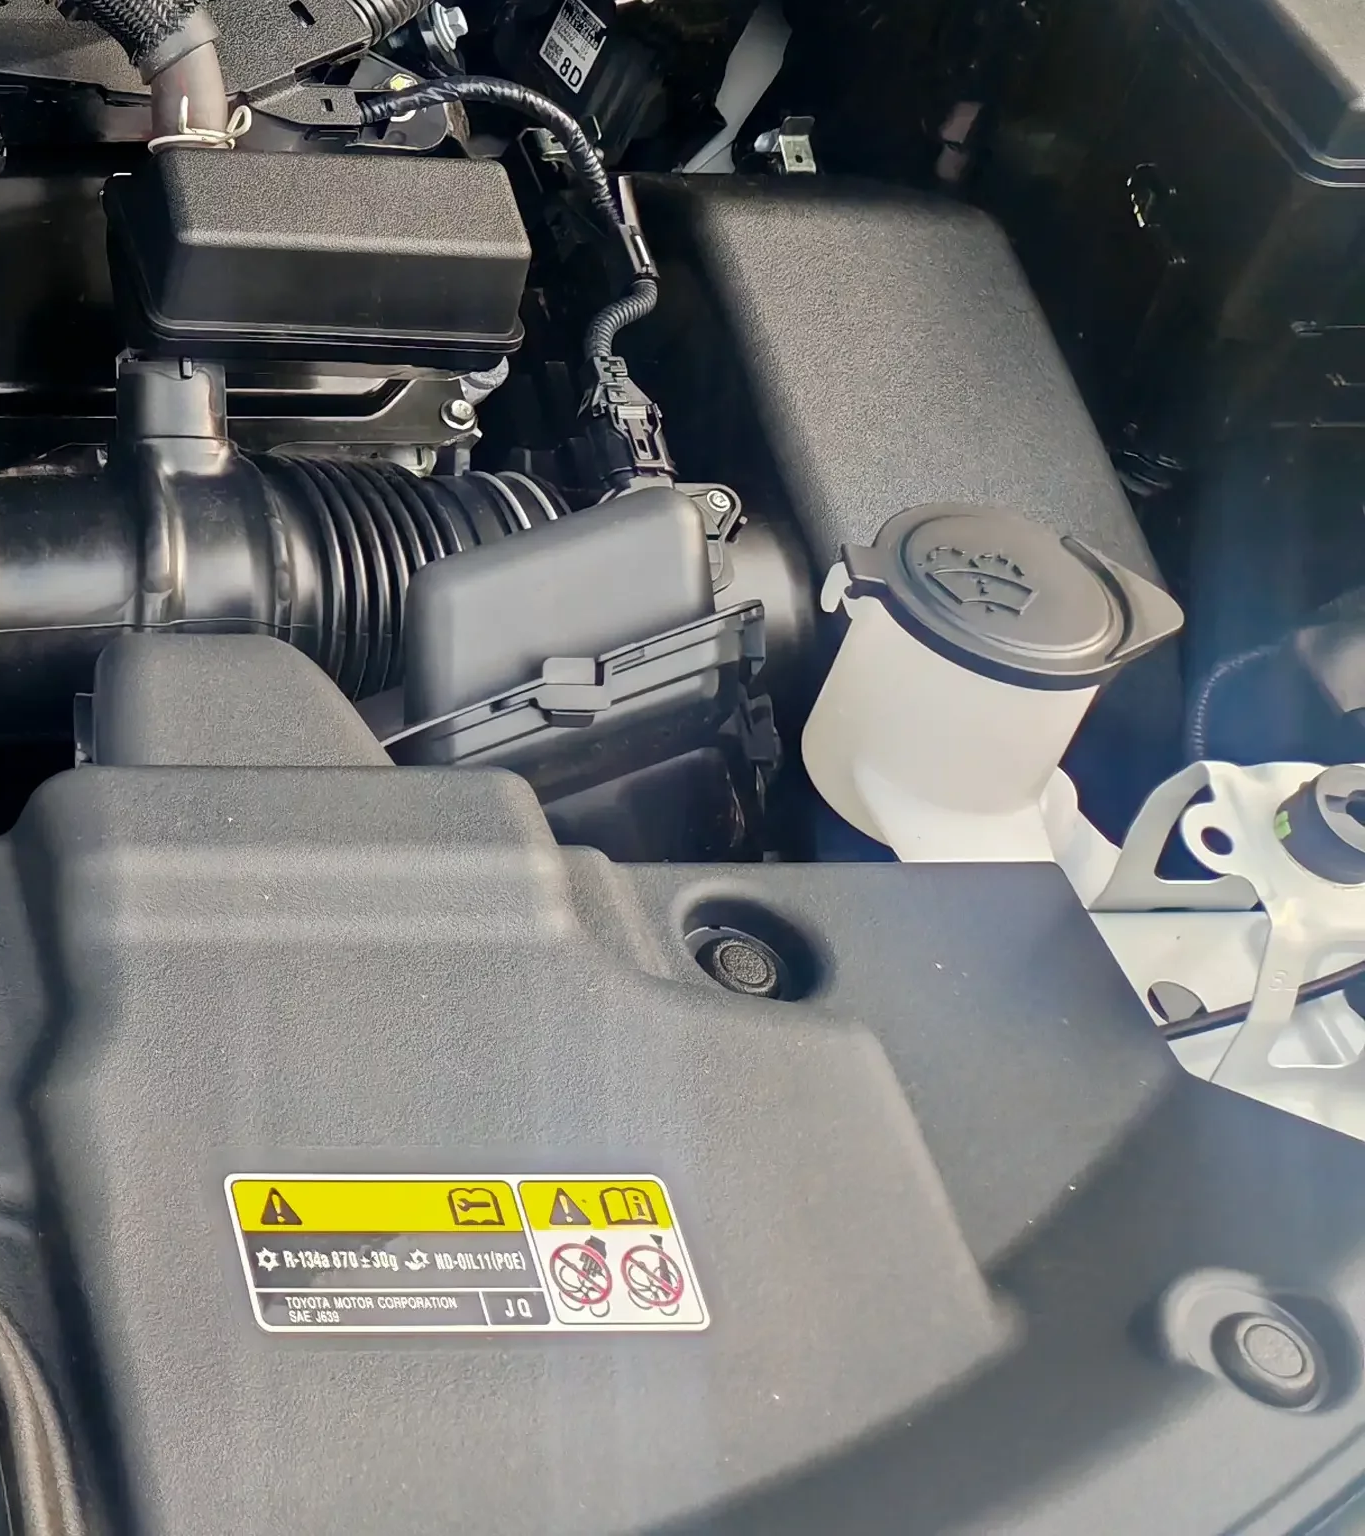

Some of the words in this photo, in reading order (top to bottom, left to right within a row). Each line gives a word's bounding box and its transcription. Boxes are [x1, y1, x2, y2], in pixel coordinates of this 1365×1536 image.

[559, 56, 583, 88] 8D
[282, 1250, 330, 1269] R-134a
[331, 1250, 359, 1269] 870
[284, 1296, 331, 1309] TOYOTA
[334, 1296, 374, 1309] MOTOR
[377, 1296, 458, 1309] CORPORATION
[288, 1310, 313, 1323] SAE
[315, 1310, 340, 1323] J639
